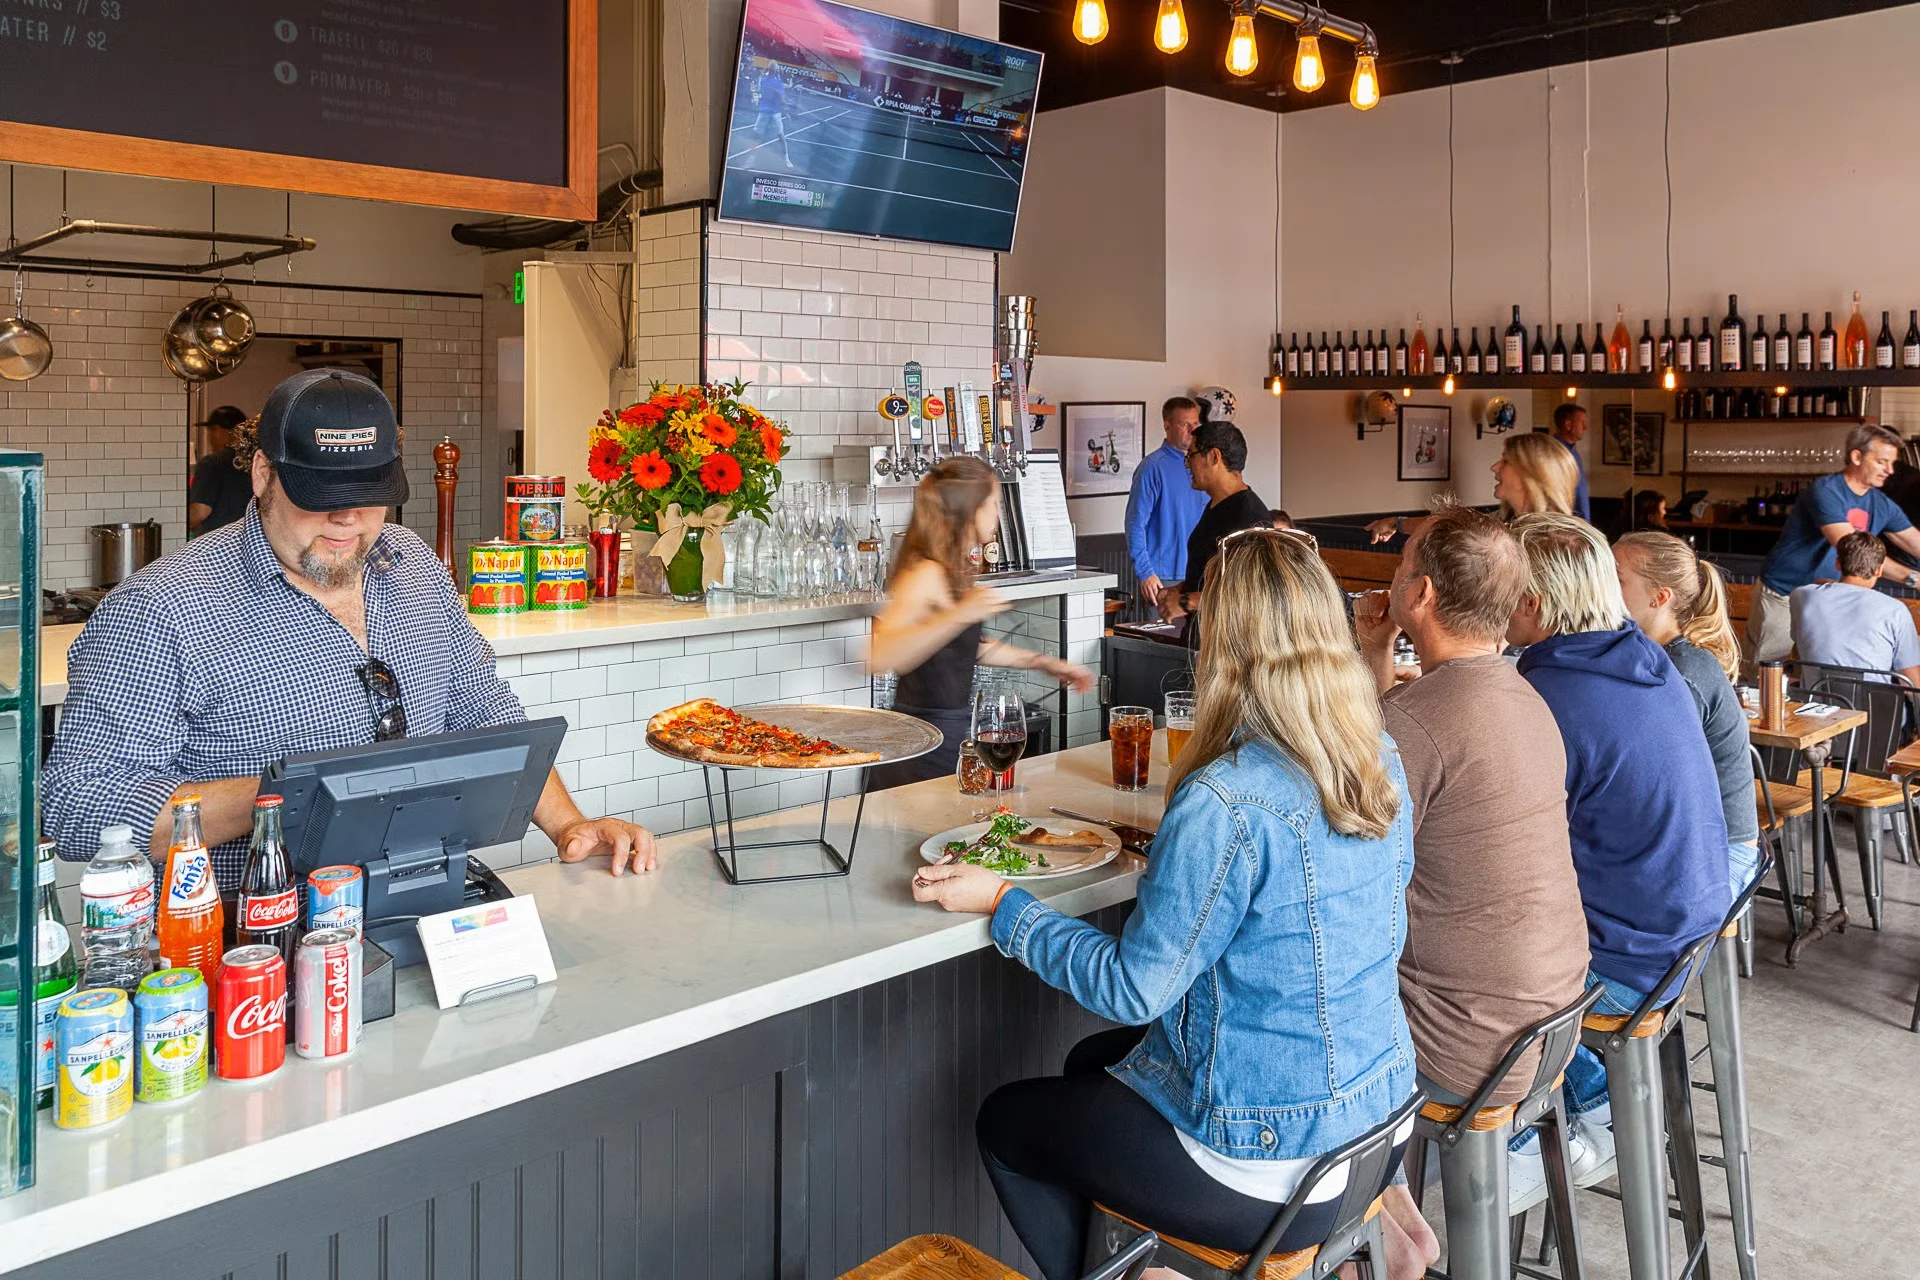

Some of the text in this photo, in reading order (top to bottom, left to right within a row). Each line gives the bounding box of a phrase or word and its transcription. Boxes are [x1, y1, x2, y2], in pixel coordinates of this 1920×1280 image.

[0, 15, 49, 42] ATER
[87, 31, 107, 51] $2
[1005, 55, 1027, 68] ROOT
[309, 69, 391, 97] PRIMAVERA
[899, 102, 942, 117] CHAMPIOHIP
[973, 115, 998, 127] GEICO
[756, 178, 777, 186] INVESCO
[764, 187, 787, 195] COURIER
[763, 194, 788, 203] McENROE
[892, 400, 900, 414] 9
[351, 431, 374, 440] PIES
[320, 444, 374, 453] PIZZERIA
[171, 855, 206, 900] Fanta
[249, 896, 297, 921] Coca-Cola
[327, 957, 349, 1013] Coke
